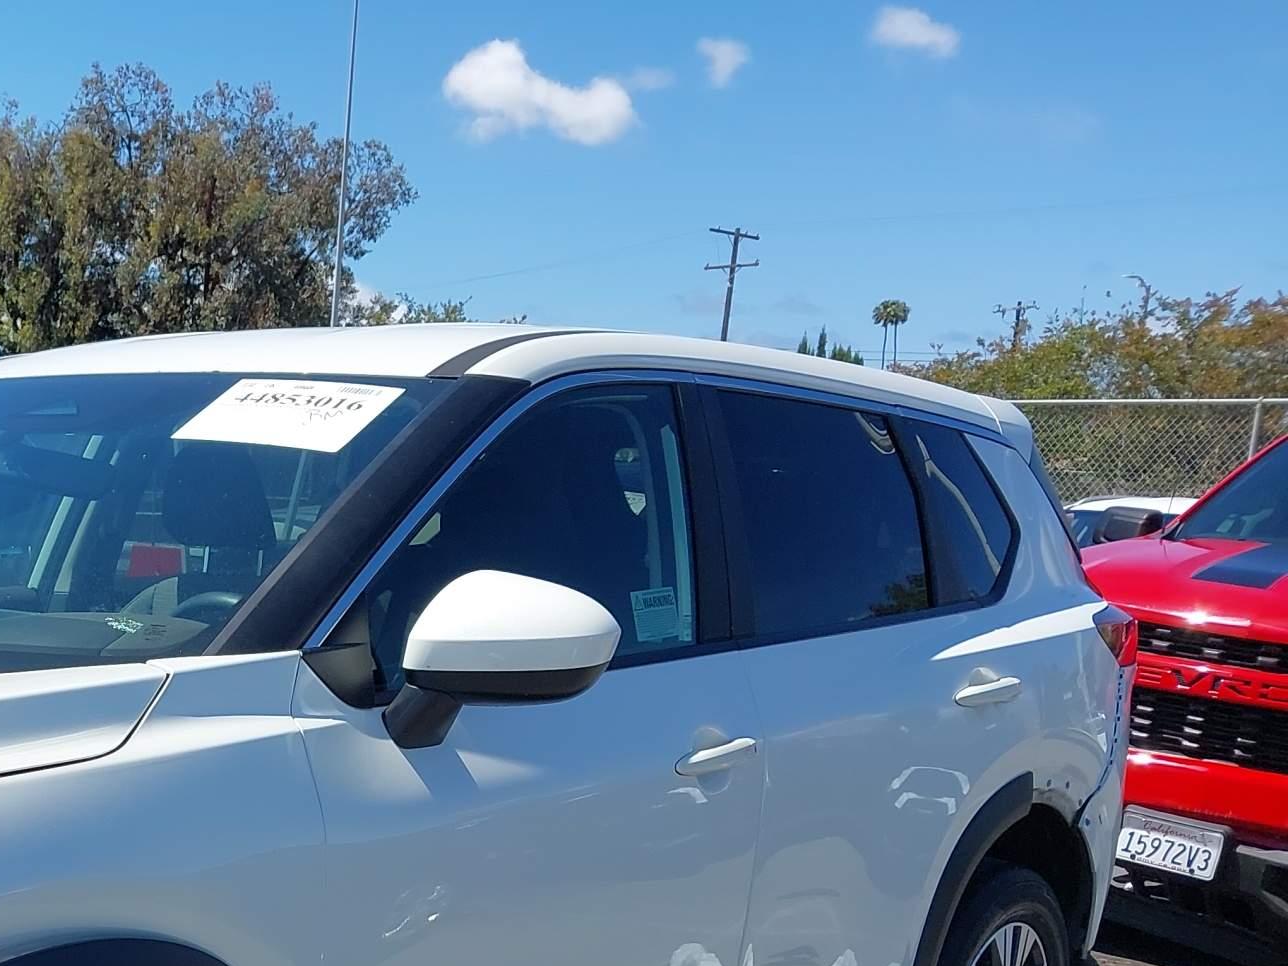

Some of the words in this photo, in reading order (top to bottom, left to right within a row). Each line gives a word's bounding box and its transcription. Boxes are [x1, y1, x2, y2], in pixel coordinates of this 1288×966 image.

[235, 392, 364, 411] 44853016
[1143, 820, 1197, 842] California
[1121, 831, 1212, 871] 15972V3
